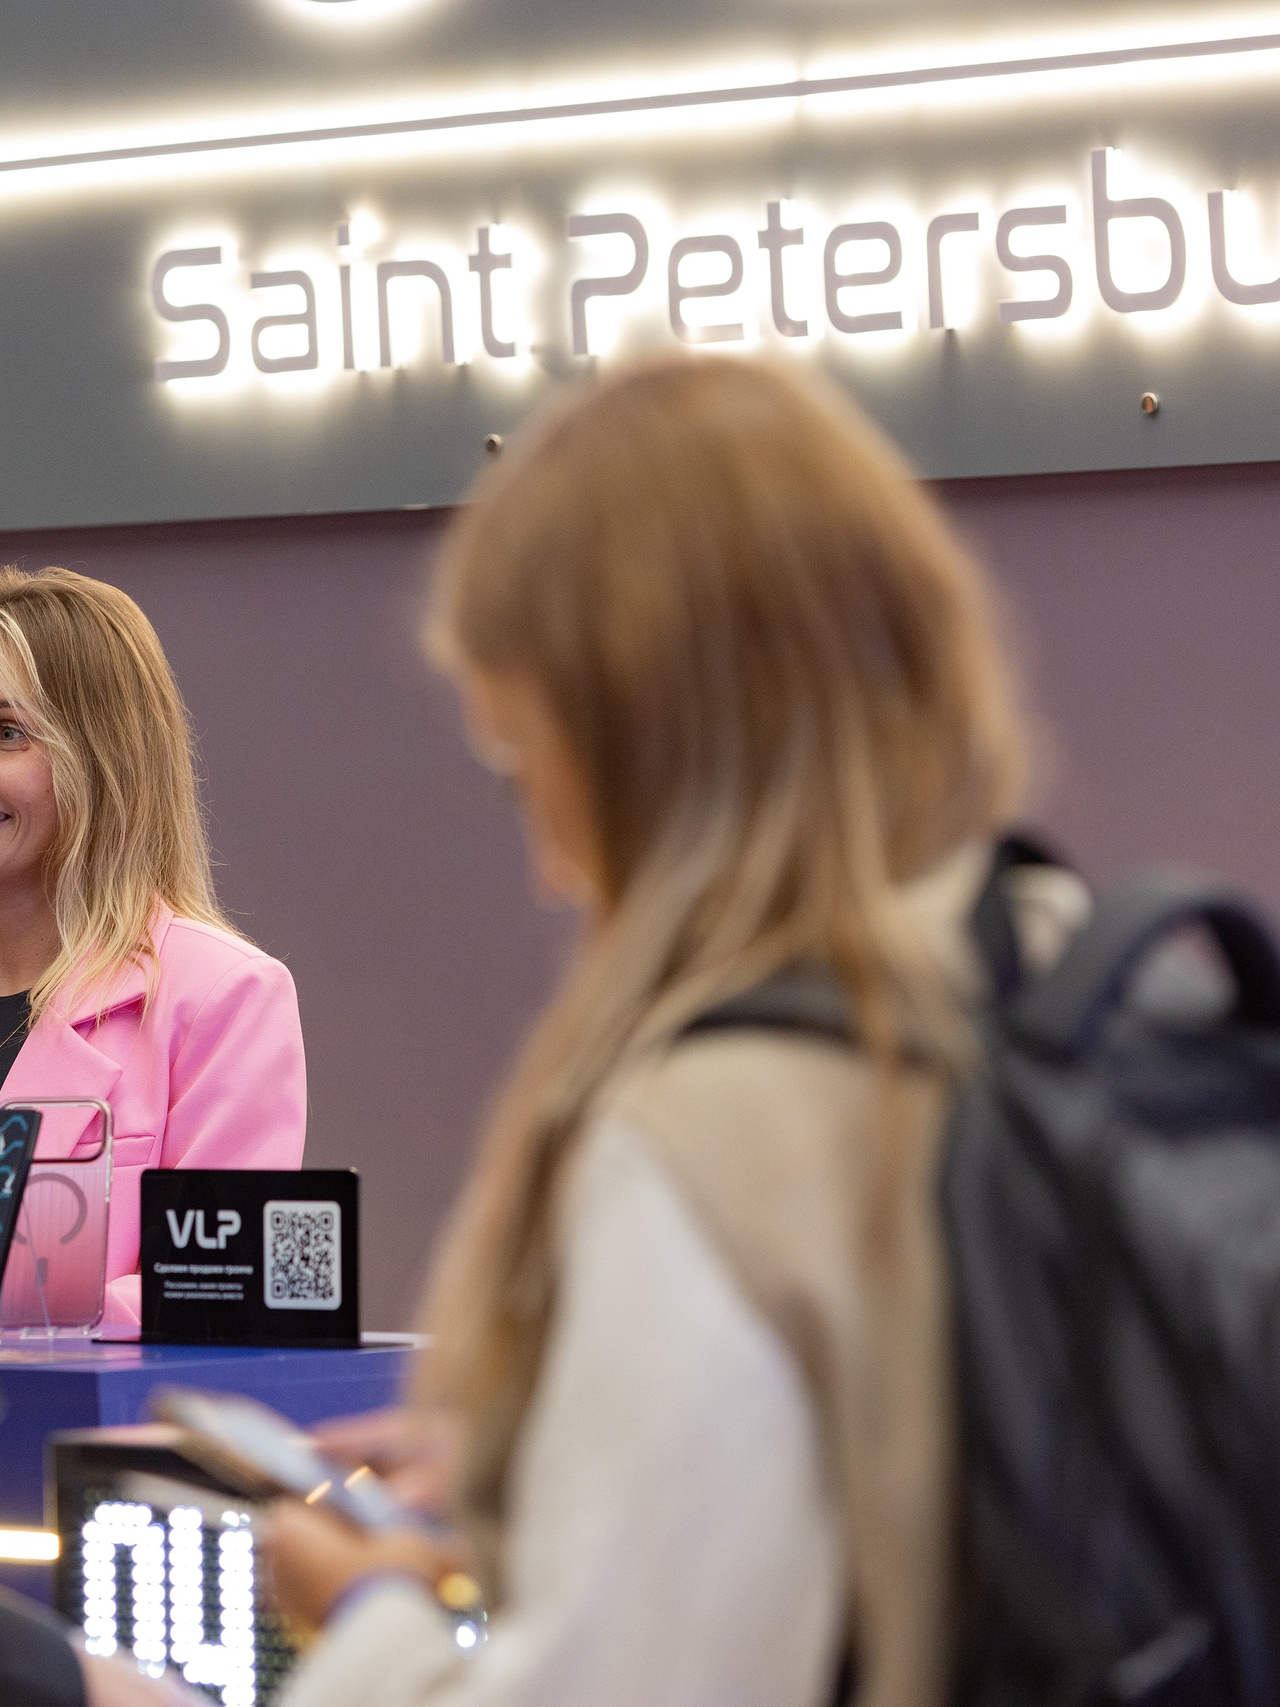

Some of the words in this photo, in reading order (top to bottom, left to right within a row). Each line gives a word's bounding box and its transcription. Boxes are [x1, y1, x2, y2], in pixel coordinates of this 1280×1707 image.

[151, 220, 518, 383] Saint
[567, 145, 1280, 357] Petersbu
[166, 1208, 242, 1250] VLP
